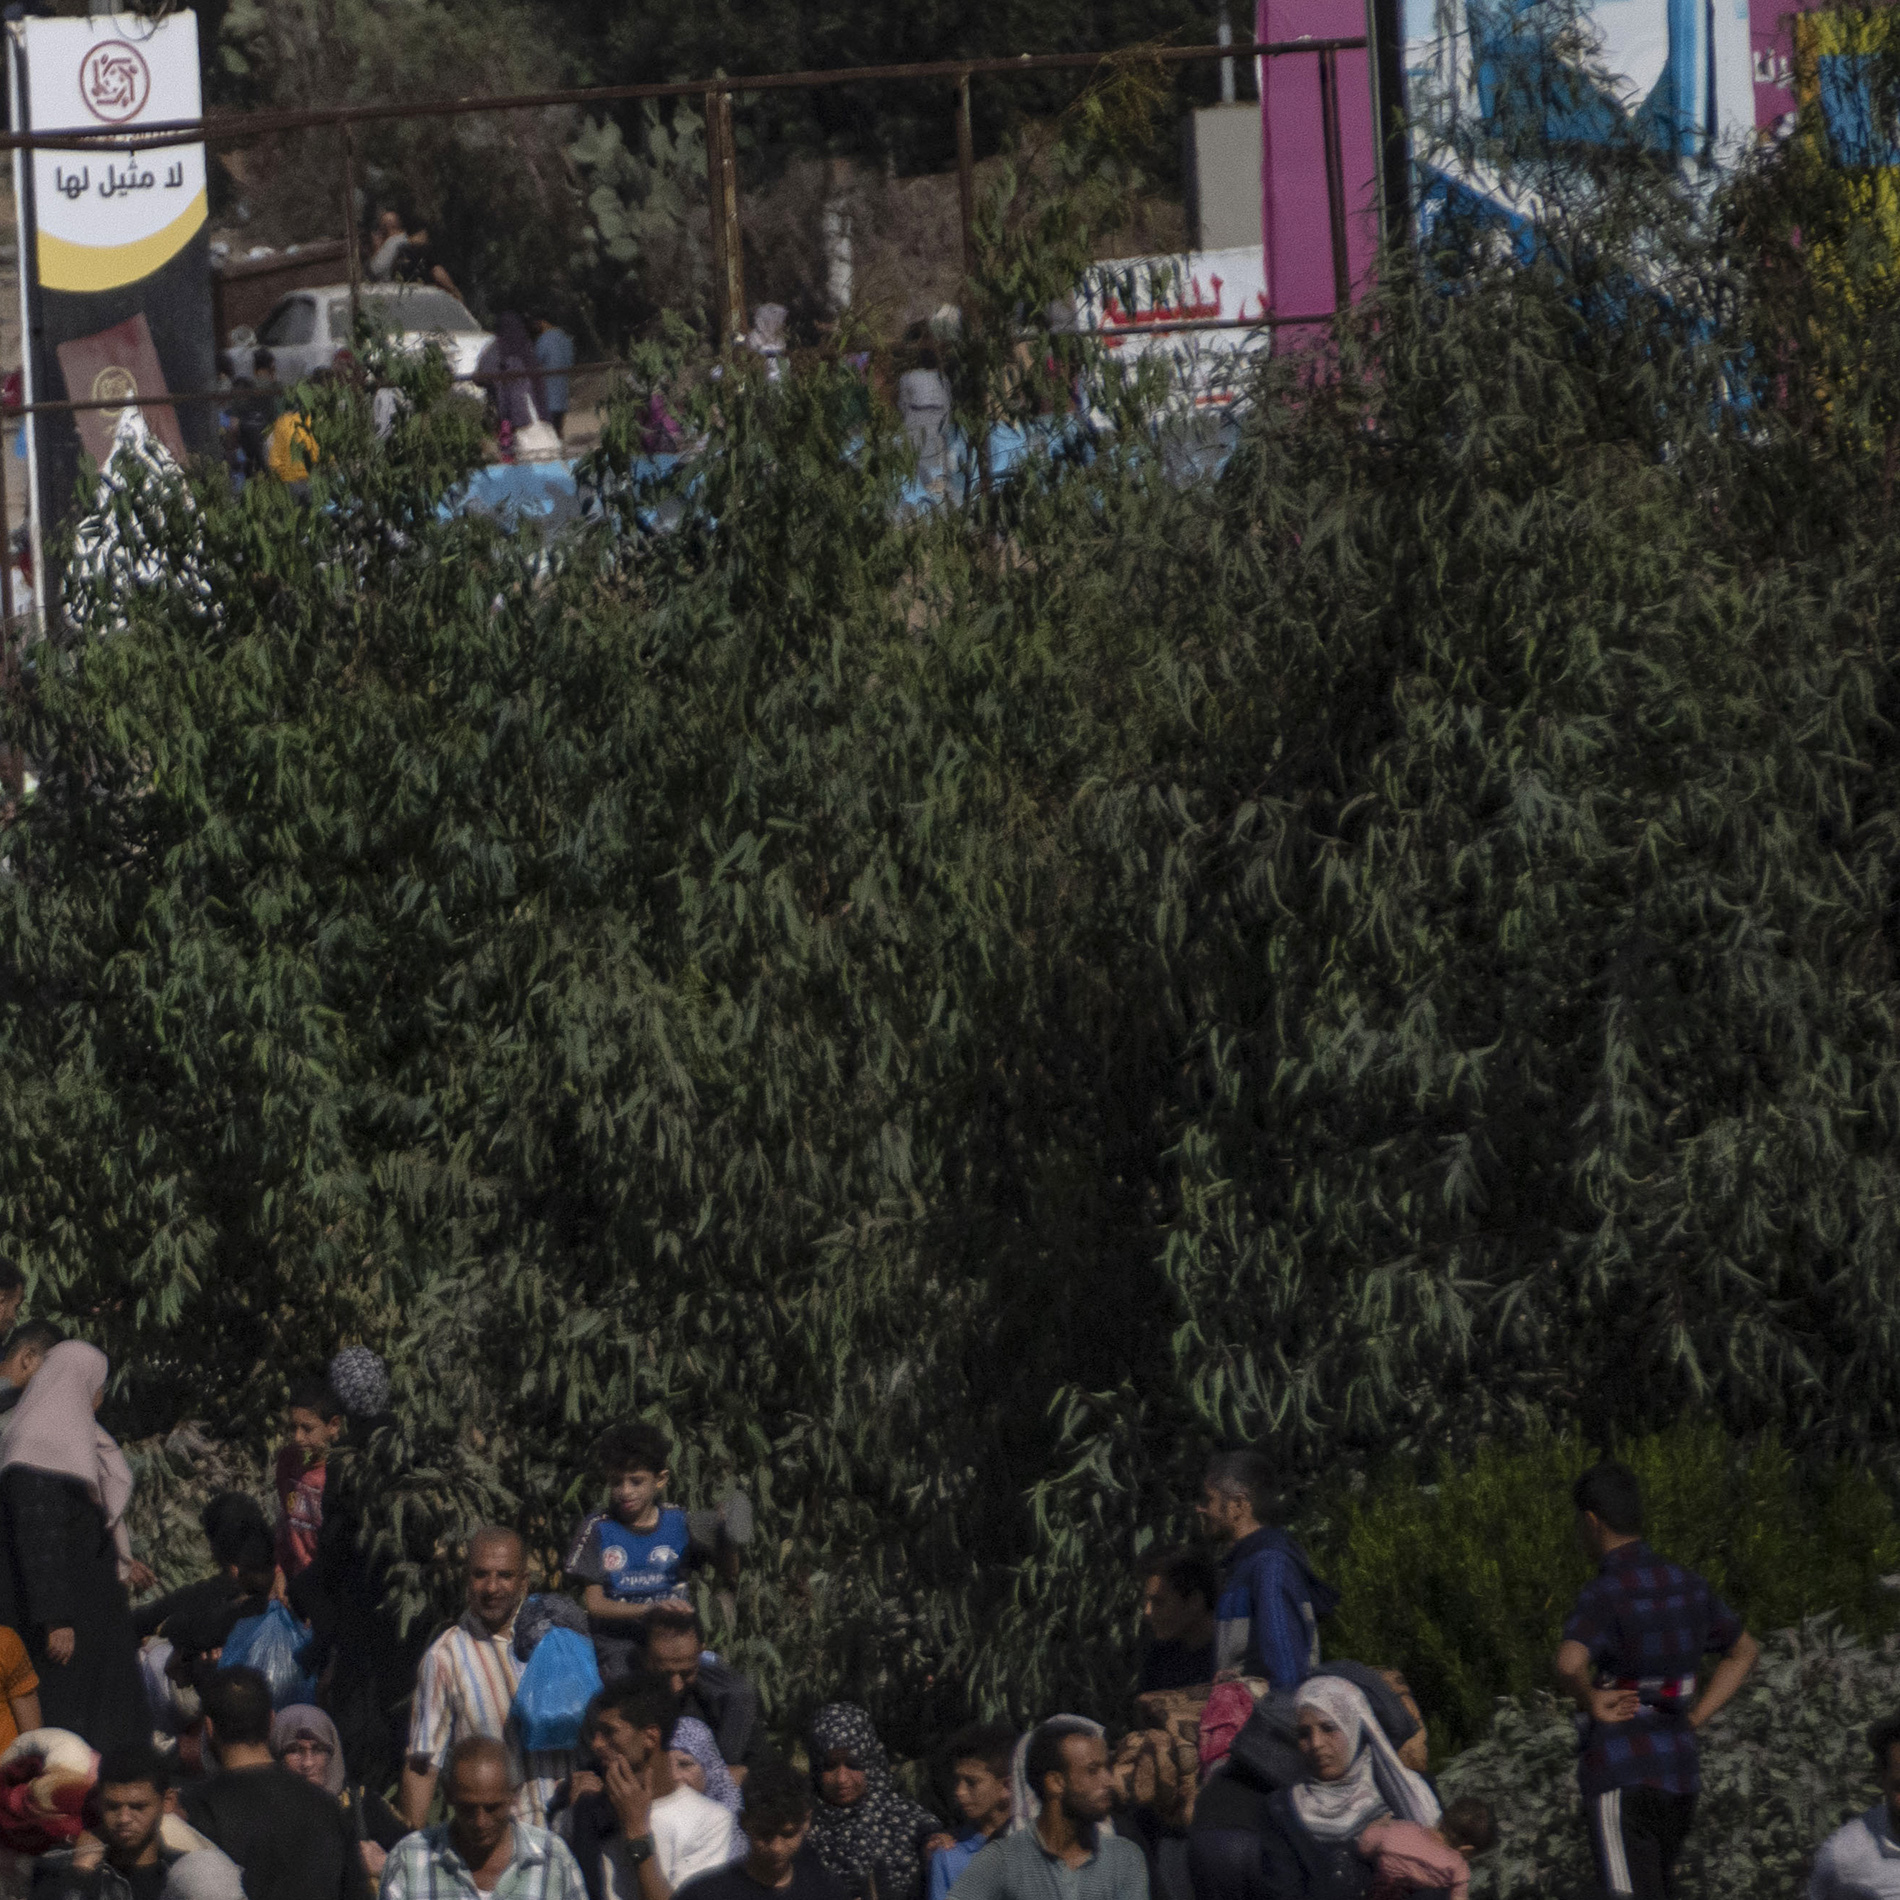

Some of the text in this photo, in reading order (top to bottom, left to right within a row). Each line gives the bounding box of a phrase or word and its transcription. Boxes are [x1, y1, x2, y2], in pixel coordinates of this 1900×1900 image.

[56, 157, 184, 200] لا مثيل لها
